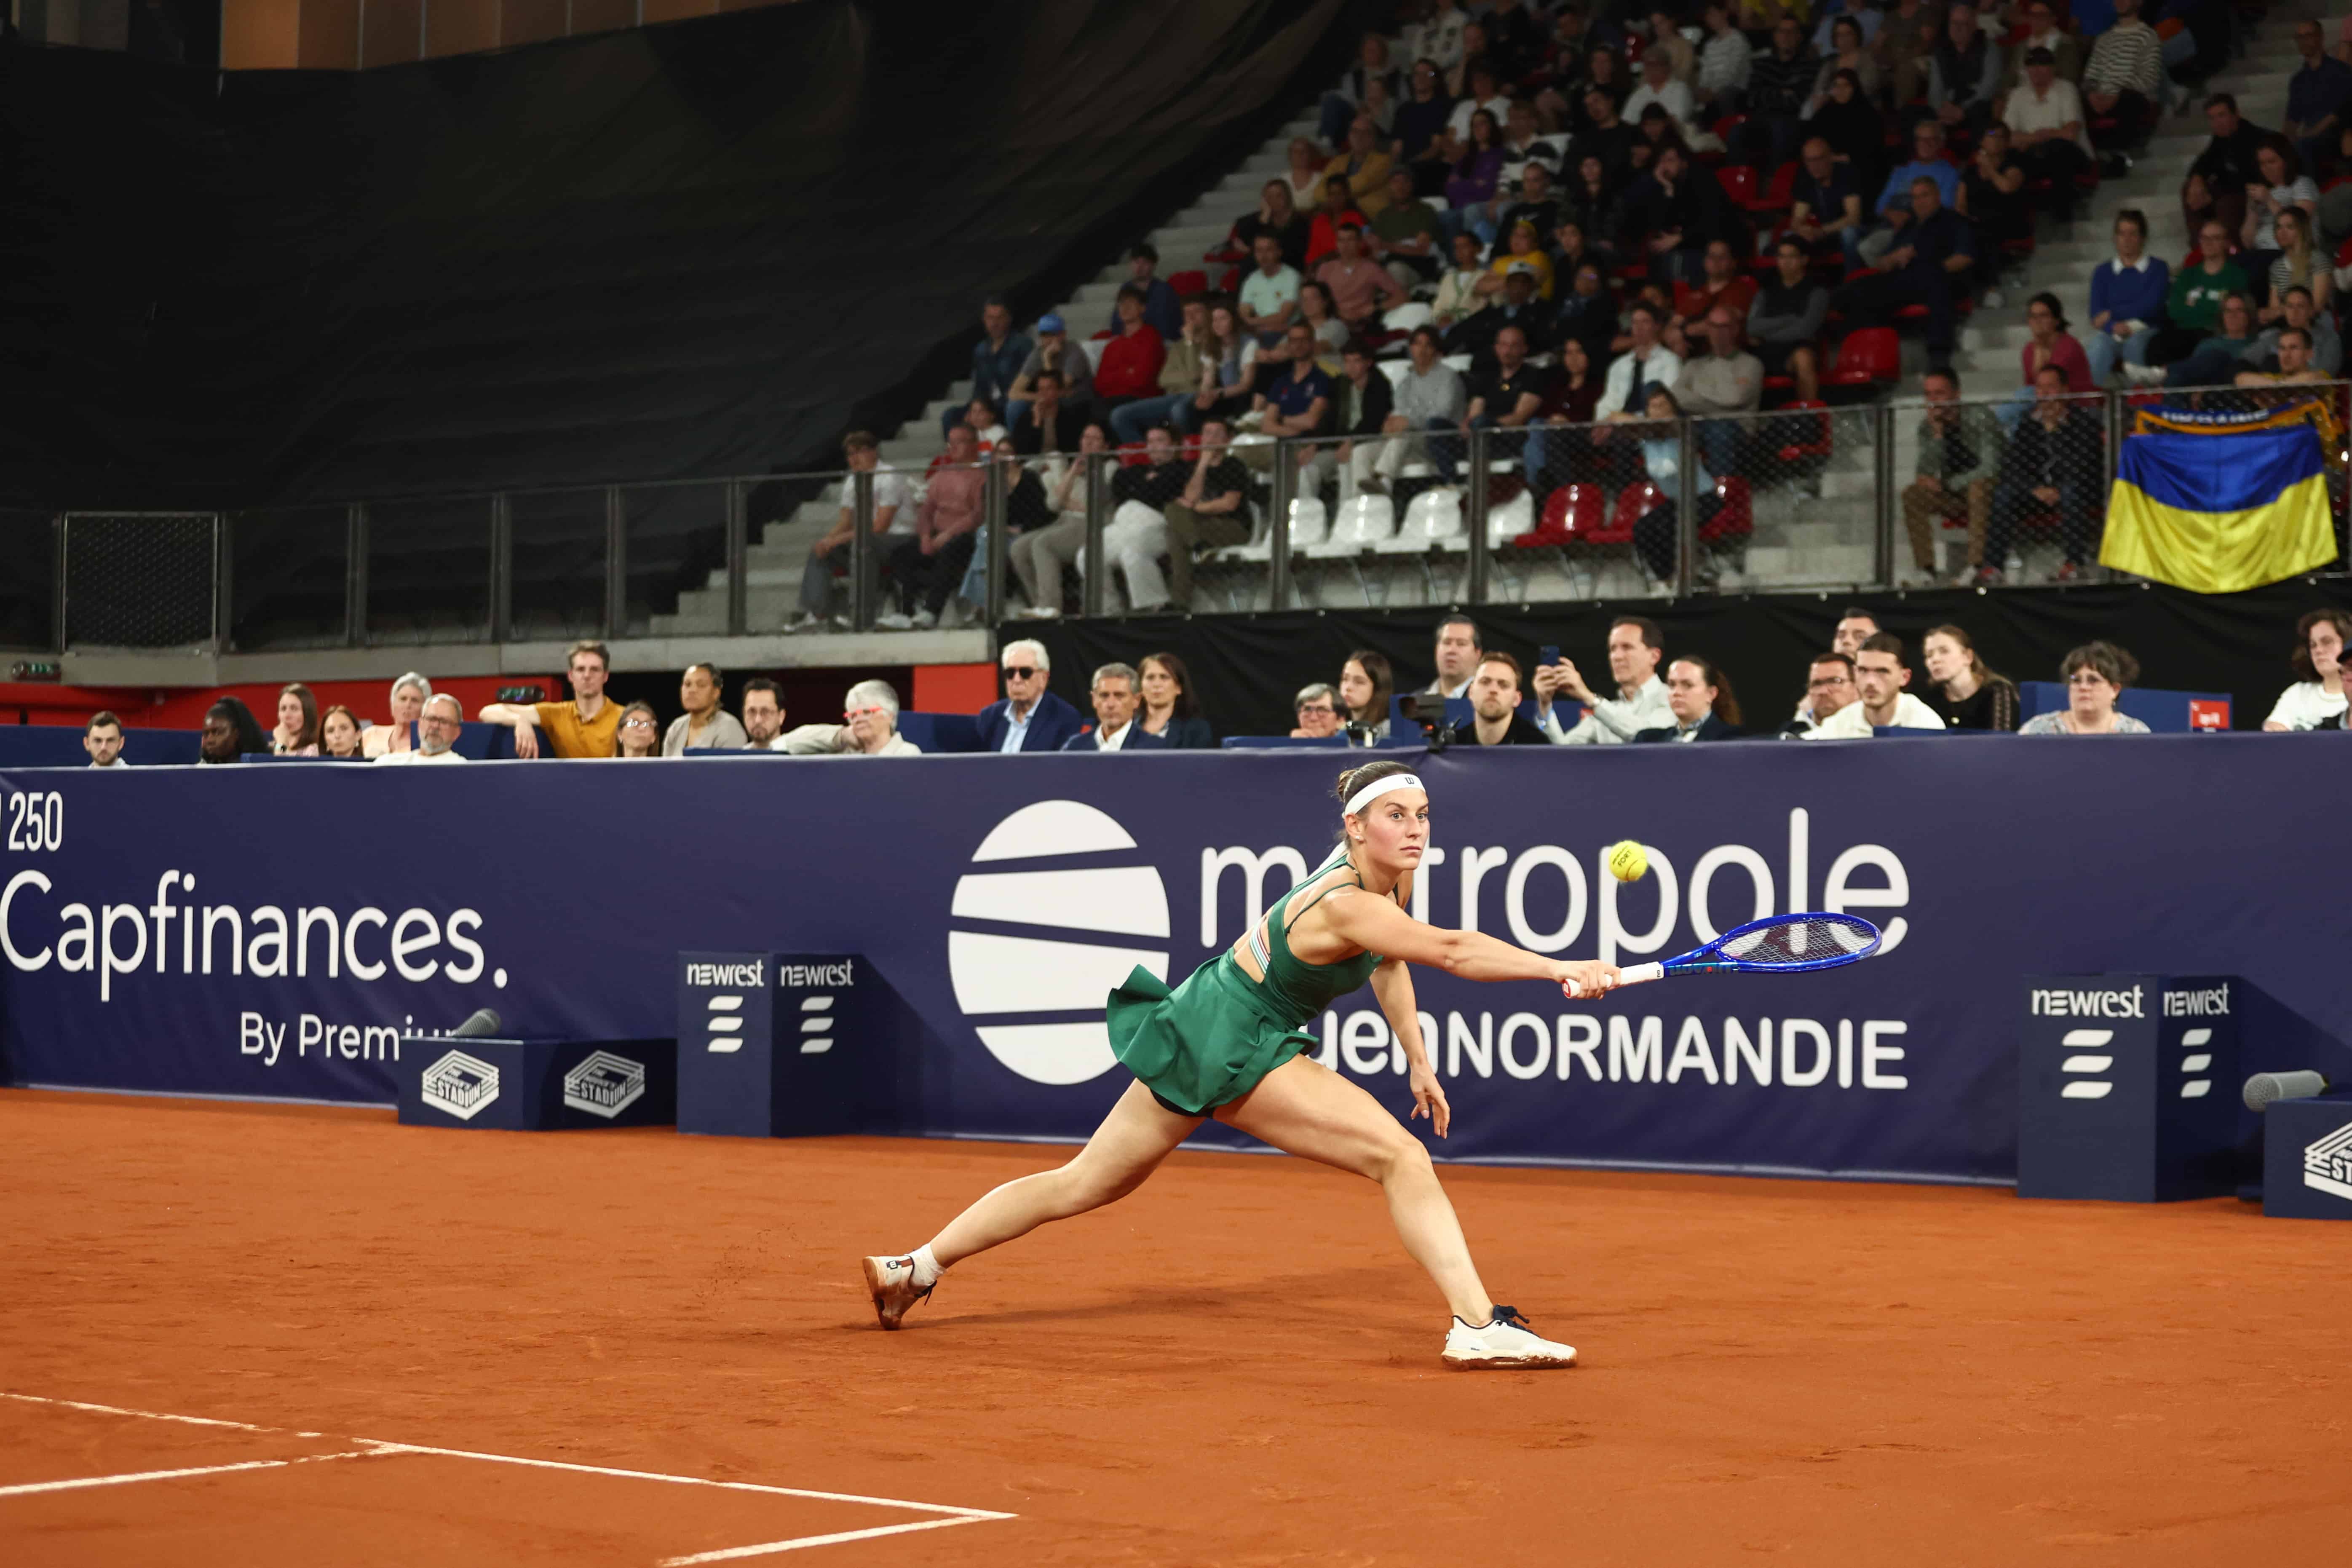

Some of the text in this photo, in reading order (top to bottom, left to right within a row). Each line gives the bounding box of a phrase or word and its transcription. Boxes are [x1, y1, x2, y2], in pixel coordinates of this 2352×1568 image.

[8, 791, 63, 852] 250
[1200, 806, 1910, 967] mtropole
[1617, 850, 1632, 867] FORT
[0, 869, 508, 1002] Capfinances.
[241, 1011, 286, 1067] By
[437, 1078, 481, 1108] STADIUM
[581, 1080, 626, 1106] STADIUM
